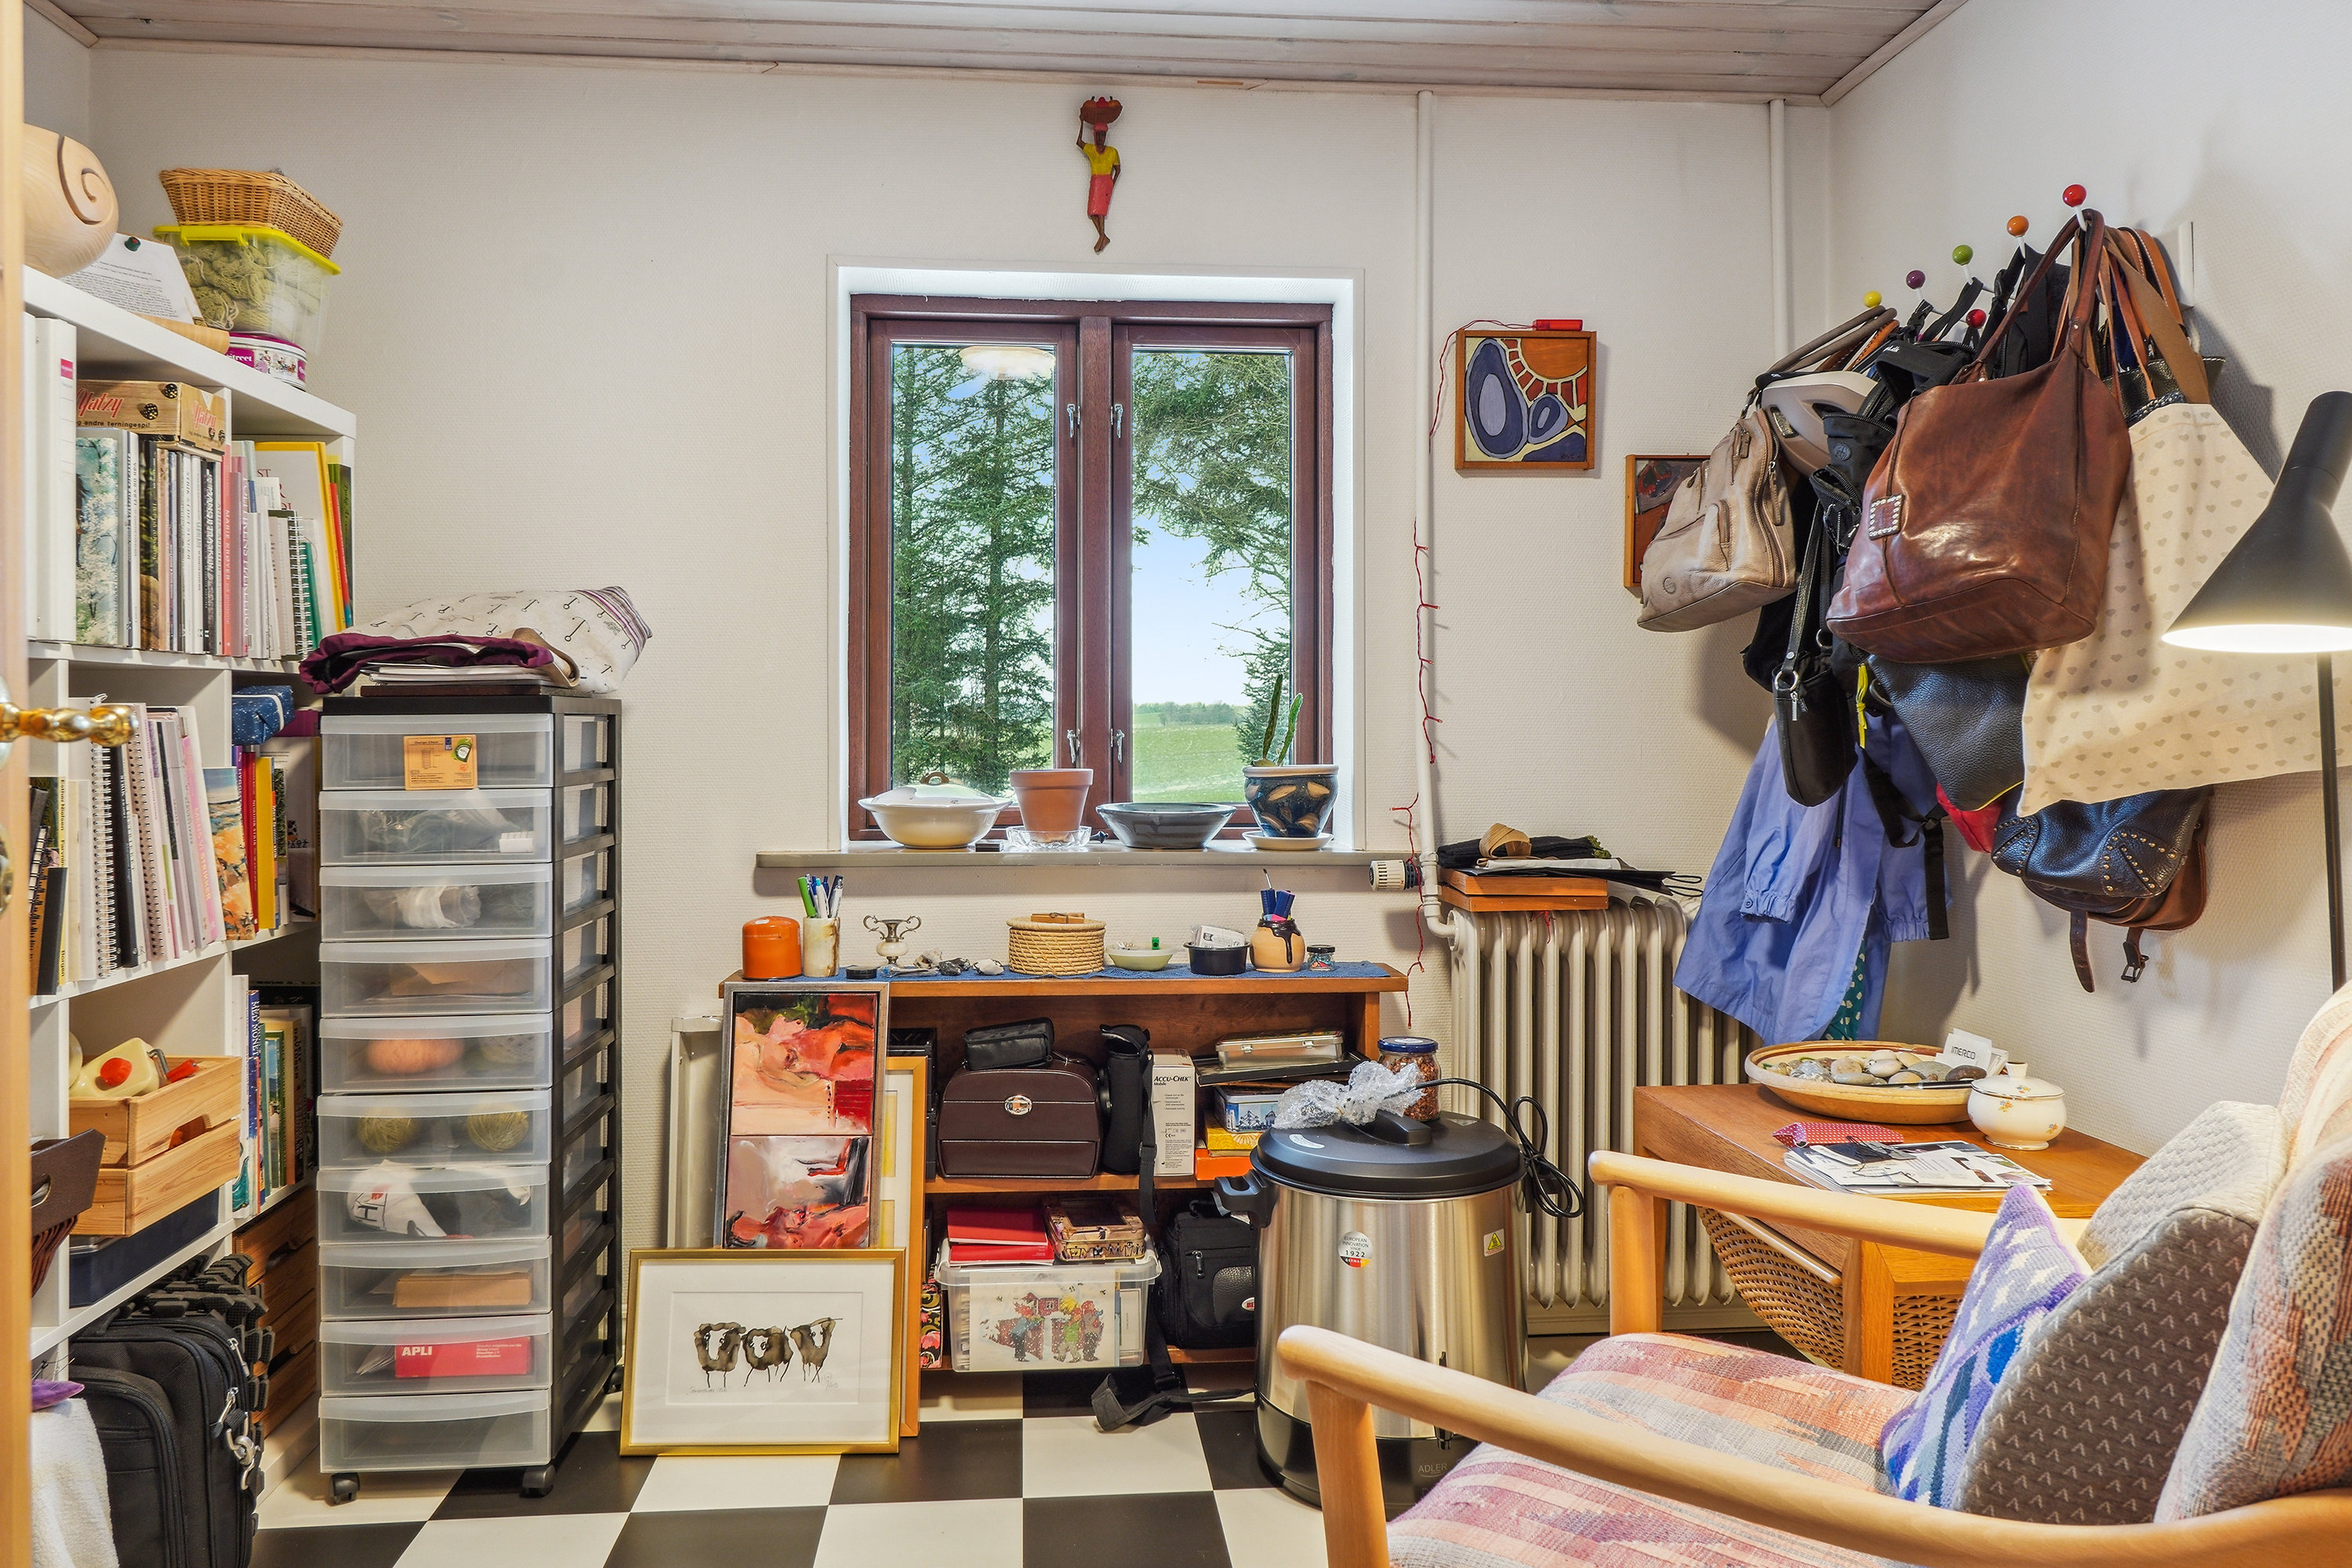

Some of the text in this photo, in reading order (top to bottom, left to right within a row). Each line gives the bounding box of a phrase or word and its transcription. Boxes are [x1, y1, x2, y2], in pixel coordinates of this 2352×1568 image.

[200, 852, 212, 902] STRIKKER
[1951, 1046, 1976, 1060] IMERCO
[1345, 1250, 1366, 1258] 1922
[401, 1345, 432, 1356] APLI
[1417, 1462, 1448, 1473] ADLER
